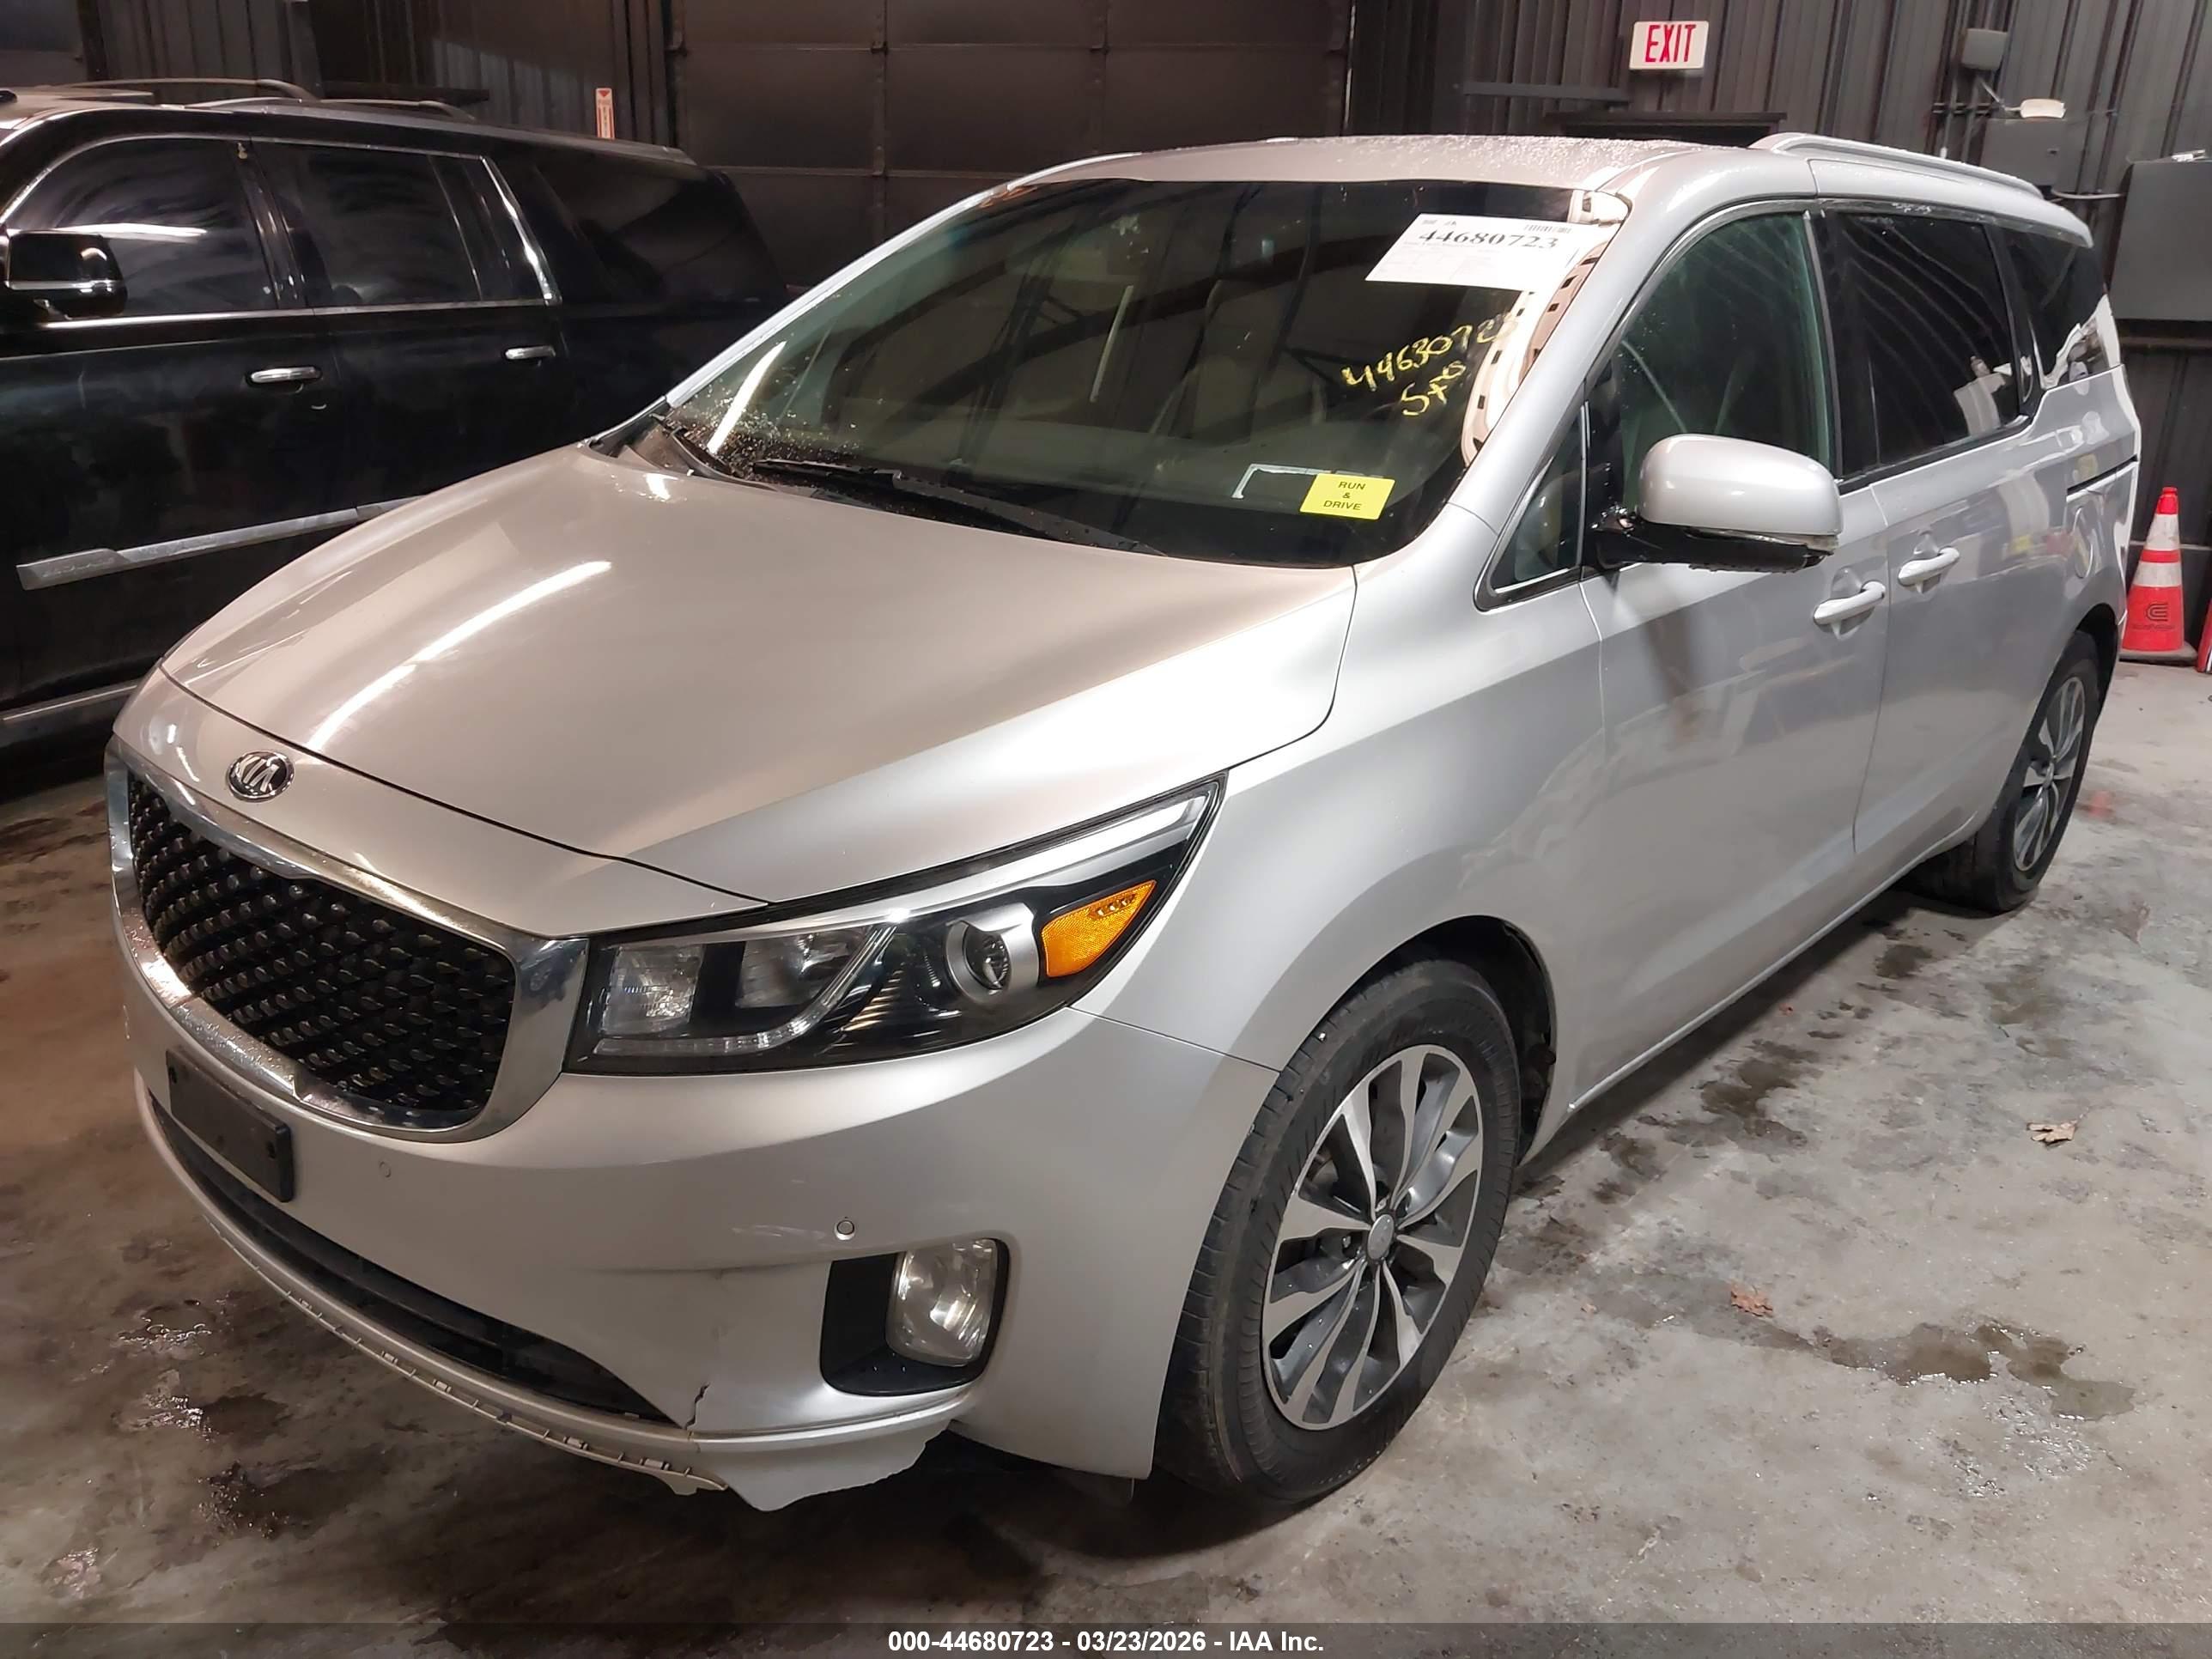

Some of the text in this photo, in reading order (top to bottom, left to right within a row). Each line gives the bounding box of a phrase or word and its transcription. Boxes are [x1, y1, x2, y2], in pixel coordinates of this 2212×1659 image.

[1646, 25, 1696, 62] EXIT
[1419, 230, 1559, 249] 44680723
[1339, 481, 1366, 490] RUN
[1323, 501, 1362, 510] DRIVE
